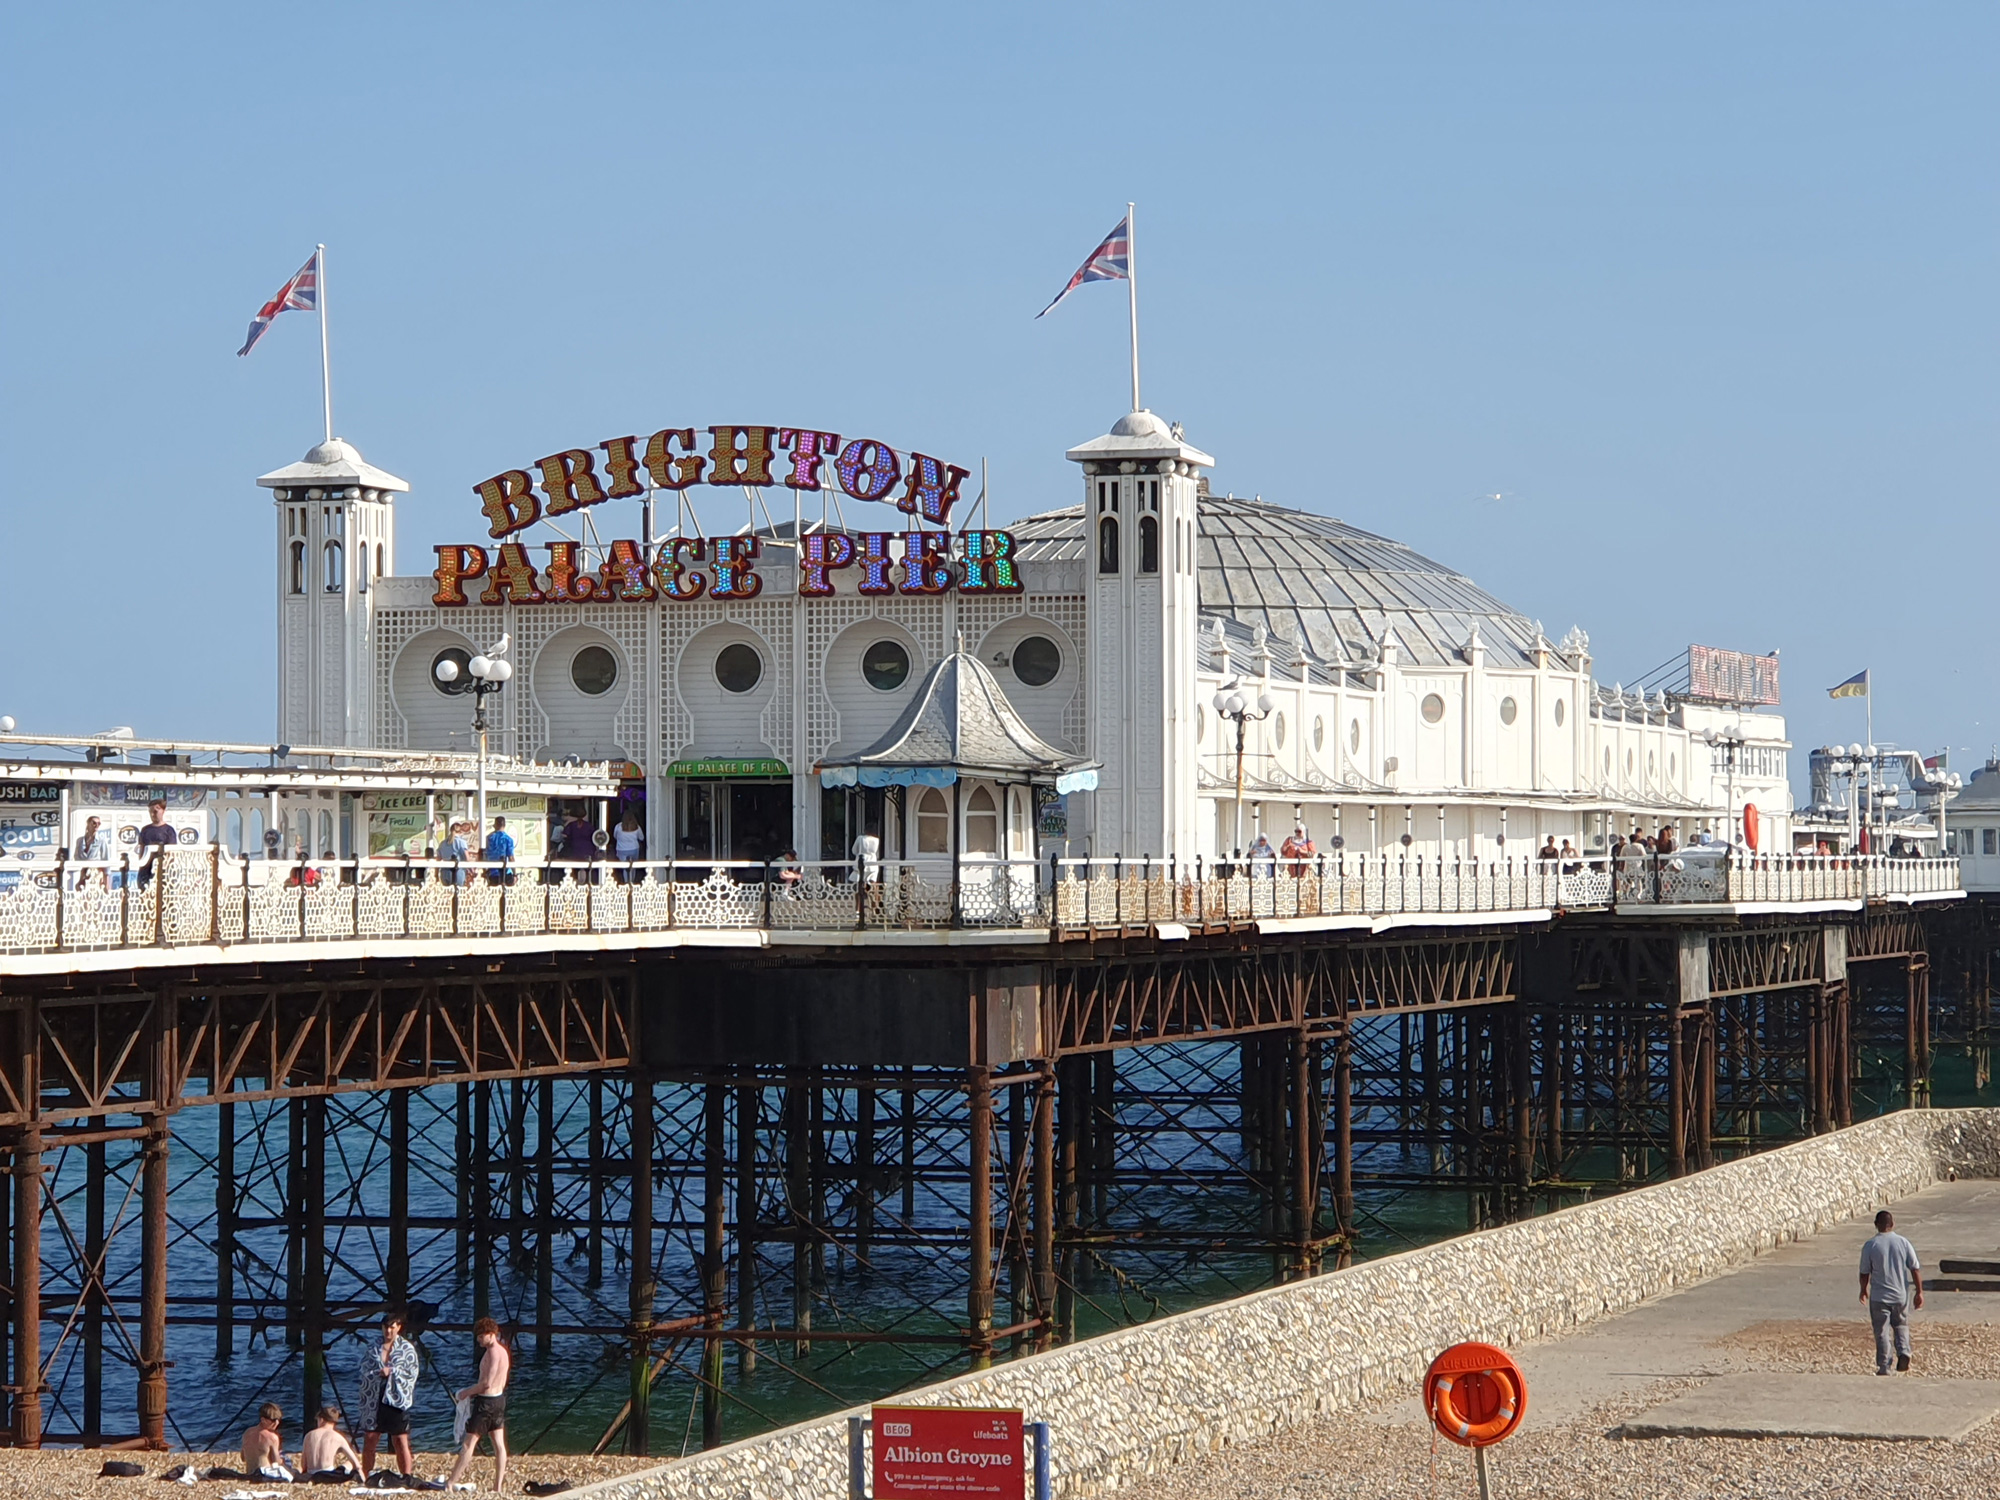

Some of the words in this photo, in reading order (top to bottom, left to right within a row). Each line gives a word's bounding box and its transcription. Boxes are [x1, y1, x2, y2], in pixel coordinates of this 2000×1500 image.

[472, 425, 971, 539] BRIGHTON
[433, 535, 763, 607] PALACE
[798, 529, 1025, 596] PIER
[672, 763, 692, 774] THE
[699, 763, 737, 774] PALACE
[742, 763, 755, 773] OF
[761, 762, 783, 773] FUN
[29, 786, 58, 799] BAR
[126, 788, 149, 800] SLUSH
[150, 789, 165, 800] BAR
[380, 798, 399, 809] ICE
[401, 795, 427, 807] CREA
[34, 812, 60, 825] £5.9
[0, 827, 49, 845] OOL!
[1442, 1354, 1500, 1370] LIFEBUOY
[885, 1424, 910, 1435] BE06
[973, 1430, 1009, 1440] Lifeboats
[883, 1446, 944, 1464] Albion
[946, 1448, 1012, 1468] Groyne
